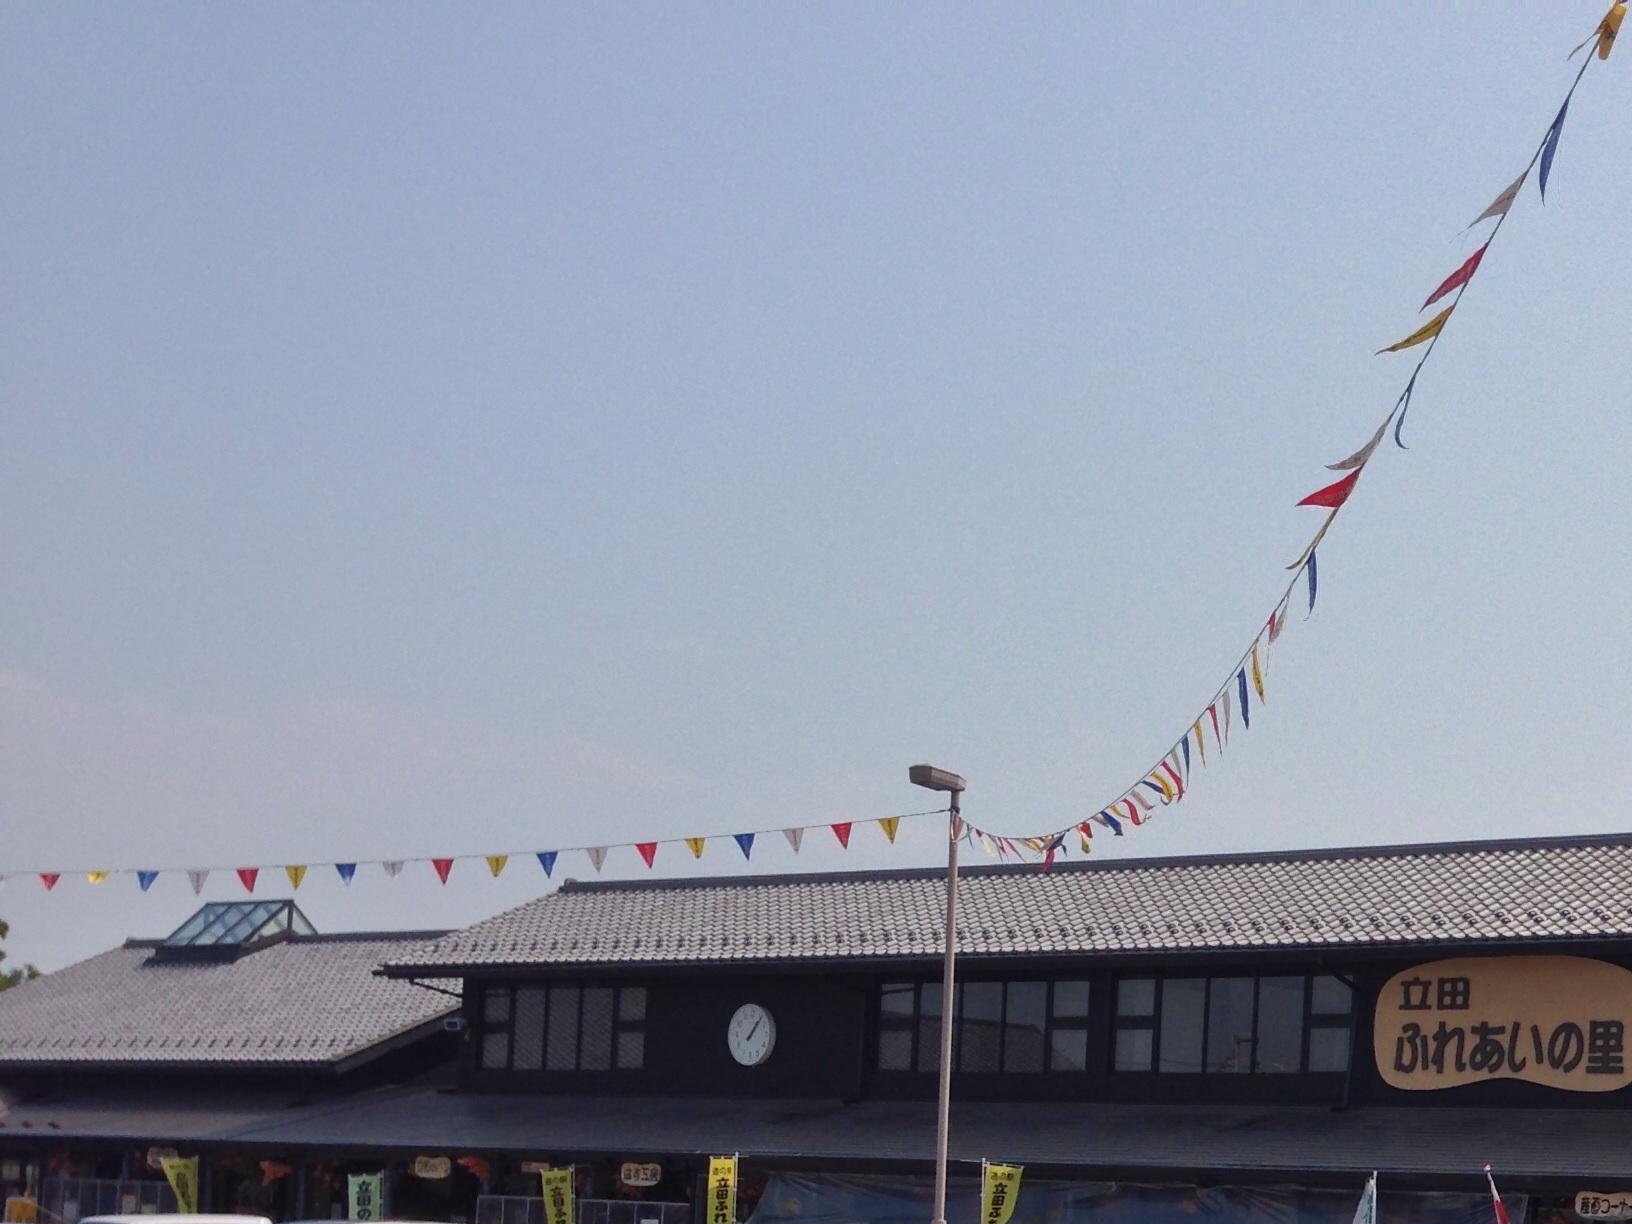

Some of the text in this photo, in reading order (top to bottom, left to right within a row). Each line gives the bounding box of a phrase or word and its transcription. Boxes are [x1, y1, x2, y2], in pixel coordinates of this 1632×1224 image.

[1398, 976, 1471, 1011] 立田
[1393, 1019, 1625, 1076] ふれあいの里
